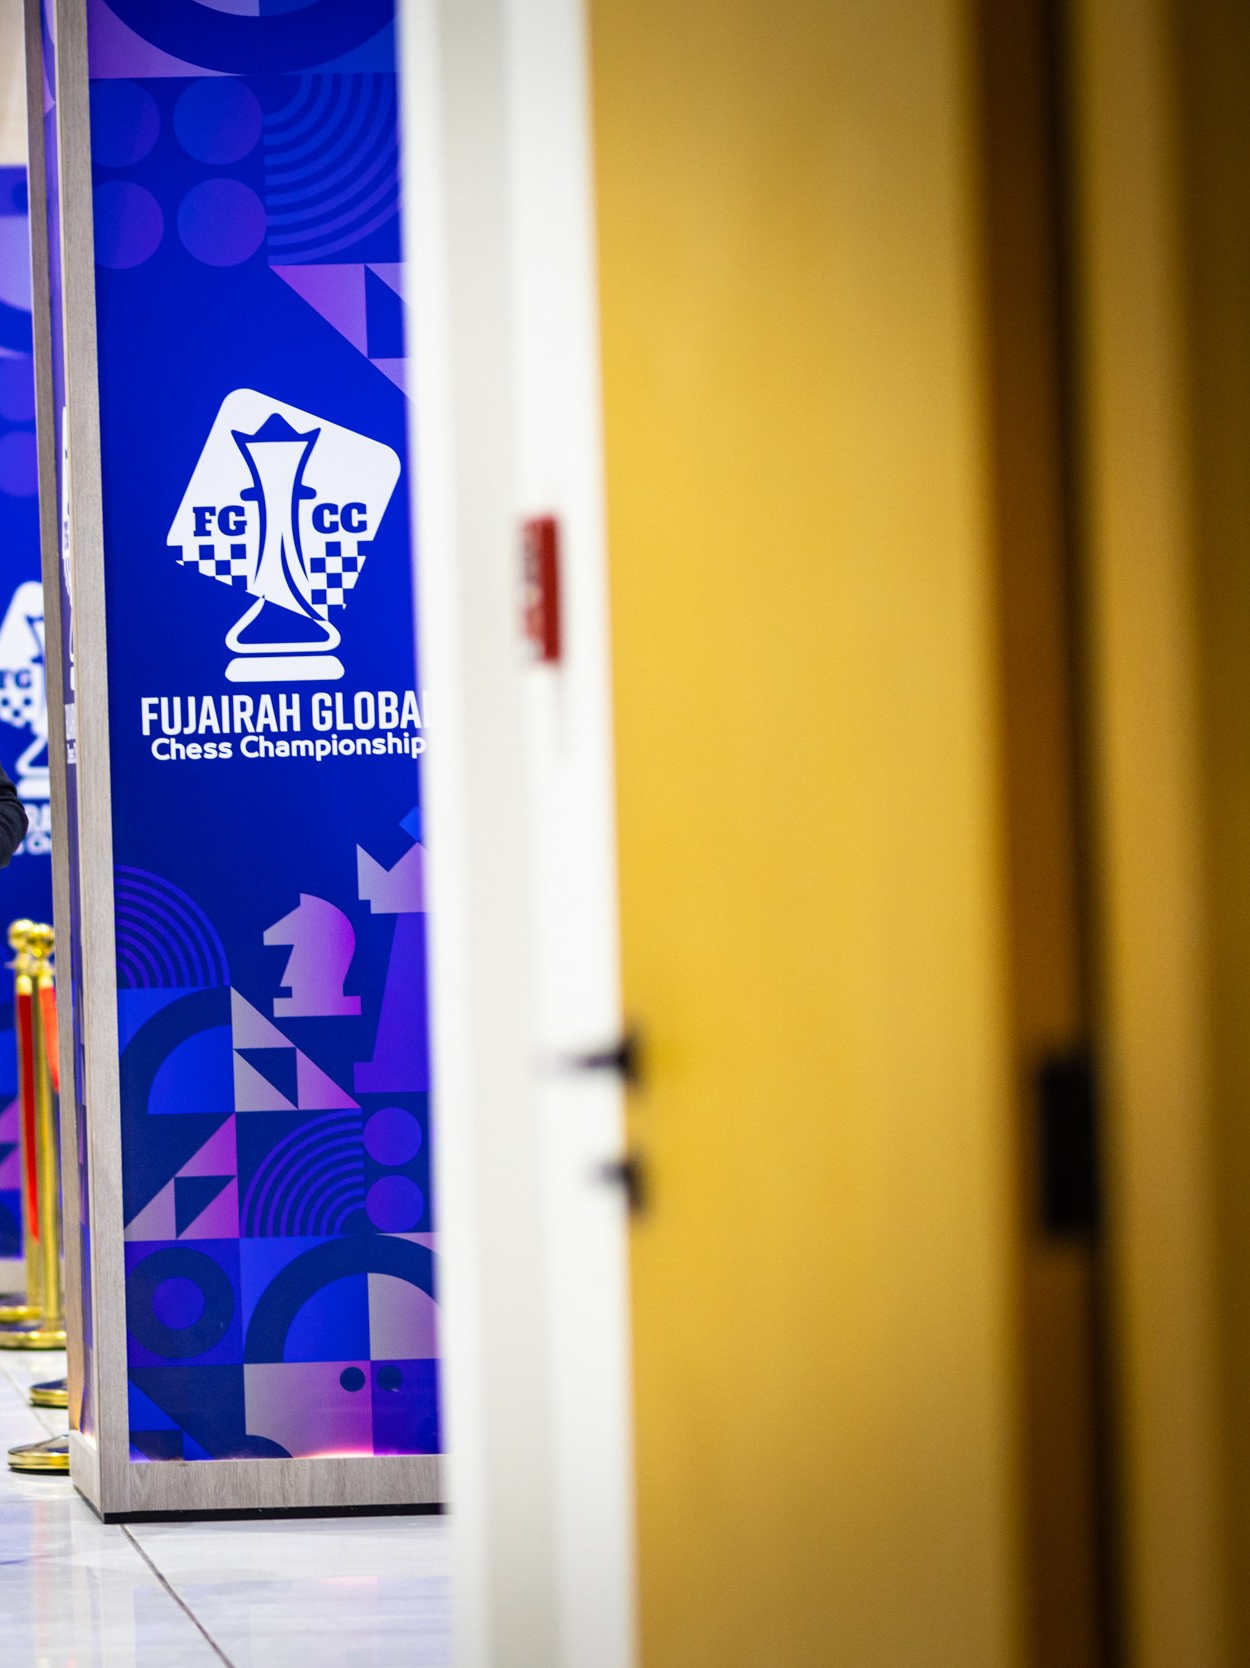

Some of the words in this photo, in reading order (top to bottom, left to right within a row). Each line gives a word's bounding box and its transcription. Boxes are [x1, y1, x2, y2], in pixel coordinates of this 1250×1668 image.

[192, 504, 248, 537] FG
[312, 502, 368, 534] CC
[141, 693, 302, 736] FUJAIRAH
[151, 737, 233, 760] Chess
[240, 732, 427, 761] Championship
